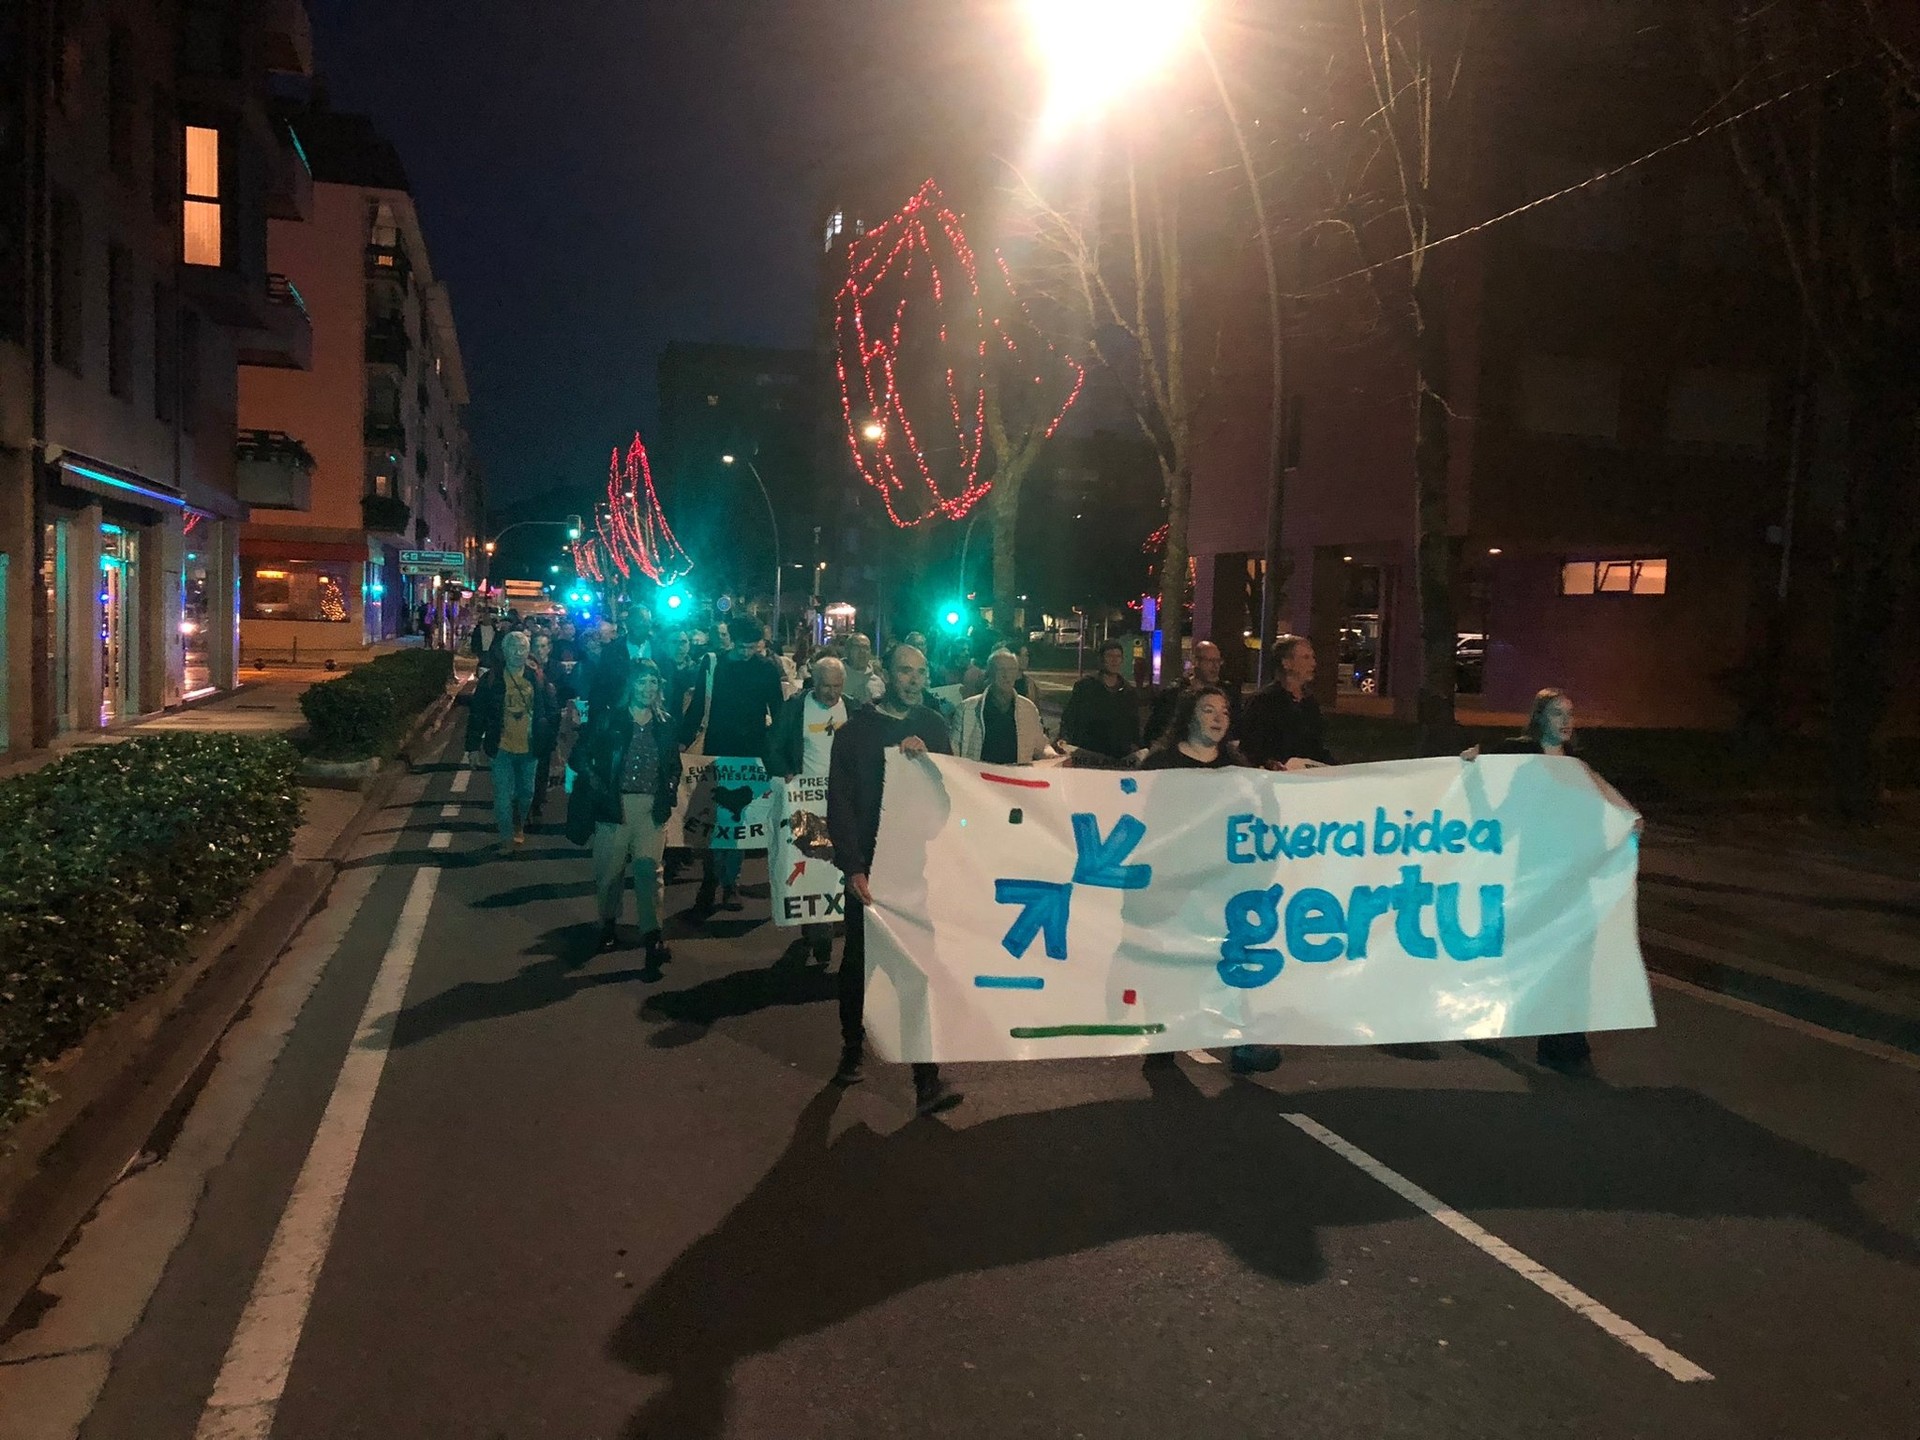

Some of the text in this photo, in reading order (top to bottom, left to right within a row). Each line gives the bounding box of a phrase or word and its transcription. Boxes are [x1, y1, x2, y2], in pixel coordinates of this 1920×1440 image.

[685, 774, 708, 783] ETA
[689, 764, 736, 775] EUSKAL
[684, 819, 765, 840] ETXER
[1226, 806, 1503, 864] Etxera bidea
[783, 892, 845, 920] ETX
[1216, 864, 1505, 989] gertu
